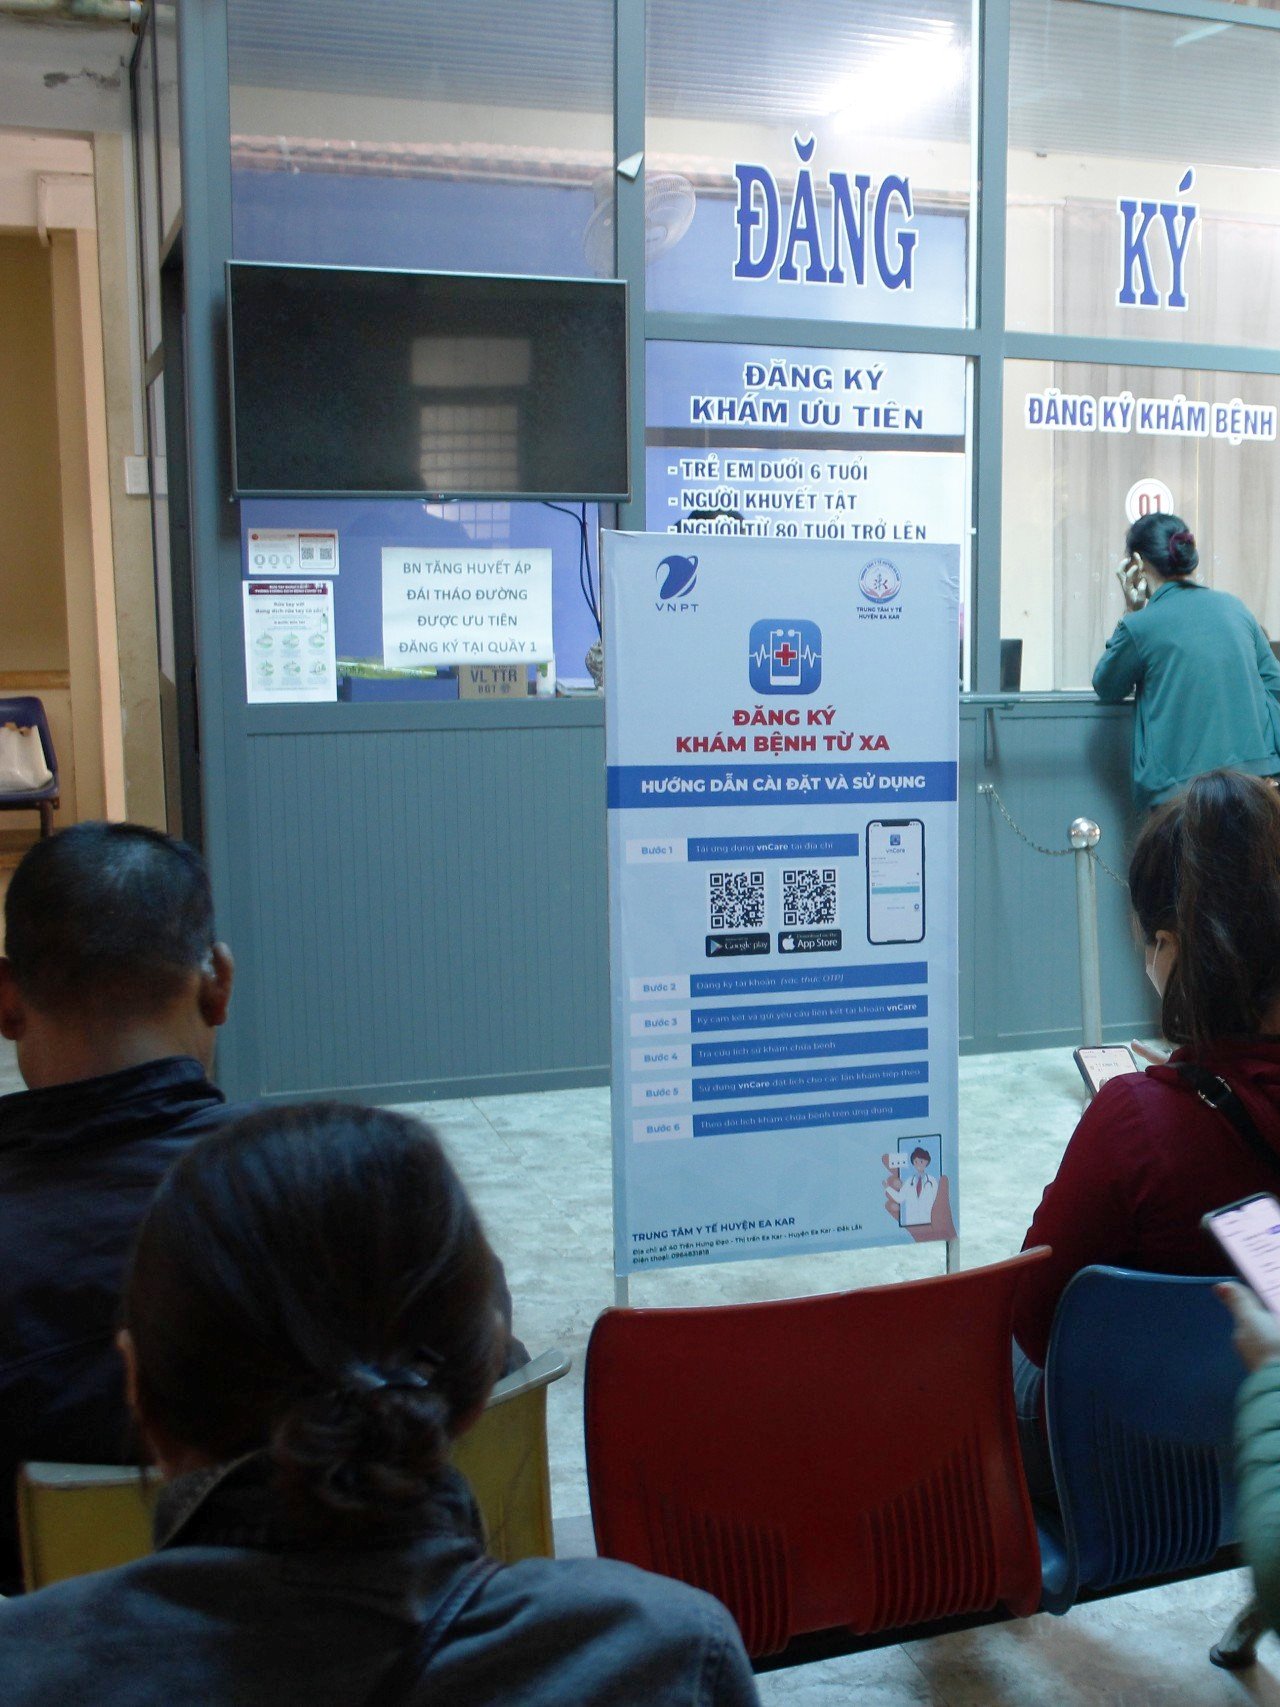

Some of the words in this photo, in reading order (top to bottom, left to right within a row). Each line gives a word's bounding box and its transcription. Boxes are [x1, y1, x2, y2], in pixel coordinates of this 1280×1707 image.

[733, 131, 918, 290] ĐĂNG
[1118, 167, 1197, 309] KÝ
[745, 359, 832, 391] ĐĂNG
[842, 361, 884, 391] KÝ
[691, 391, 789, 426] KHÁM
[801, 400, 845, 427] ƯU
[853, 397, 925, 430] TIÊN
[1027, 389, 1094, 426] ĐĂNG
[1103, 393, 1131, 428] KÝ
[1140, 396, 1206, 432] KHÁM
[1215, 399, 1274, 441] BỆNH
[682, 453, 719, 478] TRẺ
[727, 462, 754, 478] EM
[761, 459, 803, 480] DƯỚI
[811, 464, 821, 480] 6
[828, 456, 868, 481] TUỔI
[683, 488, 739, 509] NGƯỜI
[746, 486, 817, 510] KHUYẾT
[1138, 493, 1161, 517] 01
[776, 523, 798, 537] 80
[805, 513, 846, 540] TUỔI
[852, 519, 887, 540] TRỞ
[893, 521, 927, 541] LÊN
[403, 562, 421, 575] BN
[426, 560, 465, 576] TĂNG
[467, 559, 512, 575] HUYẾT
[514, 559, 532, 575] ÁP
[407, 586, 434, 601] ĐÁI
[437, 586, 473, 601] THÁO
[476, 586, 528, 601] ĐƯỜNG
[655, 603, 699, 613] VNPT
[417, 613, 459, 630] ĐƯỢC
[462, 613, 483, 628] ƯU
[486, 611, 518, 628] TIÊN
[399, 638, 439, 654] ĐĂNG
[442, 637, 459, 653] KÝ
[463, 641, 485, 656] TẠI
[487, 635, 526, 655] QUẦY
[529, 641, 537, 653] 1
[732, 704, 800, 727] ĐĂNG
[807, 704, 836, 726] KÝ
[676, 731, 747, 753] KHÁM
[753, 730, 817, 757] BỆNH
[823, 730, 854, 752] TỪ
[859, 734, 890, 752] XA
[641, 774, 705, 794] HƯỚNG
[710, 772, 749, 792] DẪN
[752, 774, 782, 791] CÀI
[786, 774, 821, 794] ĐẶT
[825, 772, 849, 790] VÀ
[853, 770, 876, 789] SỬ
[879, 774, 927, 794] DỤNG
[641, 845, 666, 855] Bước
[669, 846, 673, 854] 1
[757, 843, 788, 852] vnCare
[798, 939, 815, 949] App
[817, 938, 838, 947] Store
[643, 982, 668, 993] Bước
[670, 983, 676, 991] 2
[886, 1002, 917, 1012] vnCare
[644, 1017, 669, 1028] Bước
[672, 1018, 678, 1026] 3
[644, 1053, 669, 1063] Bước
[671, 1053, 678, 1061] 4
[645, 1088, 670, 1098] Bước
[673, 1087, 679, 1096] 5
[738, 1080, 770, 1090] vnCare
[646, 1123, 671, 1134] Bước
[674, 1123, 680, 1132] 6
[632, 1230, 669, 1242] TRUNG
[671, 1226, 693, 1237] TÂM
[696, 1226, 703, 1235] Y
[705, 1221, 718, 1233] TẾ
[721, 1219, 756, 1232] HUYỆN
[758, 1219, 772, 1228] EA
[774, 1216, 796, 1227] KAR
